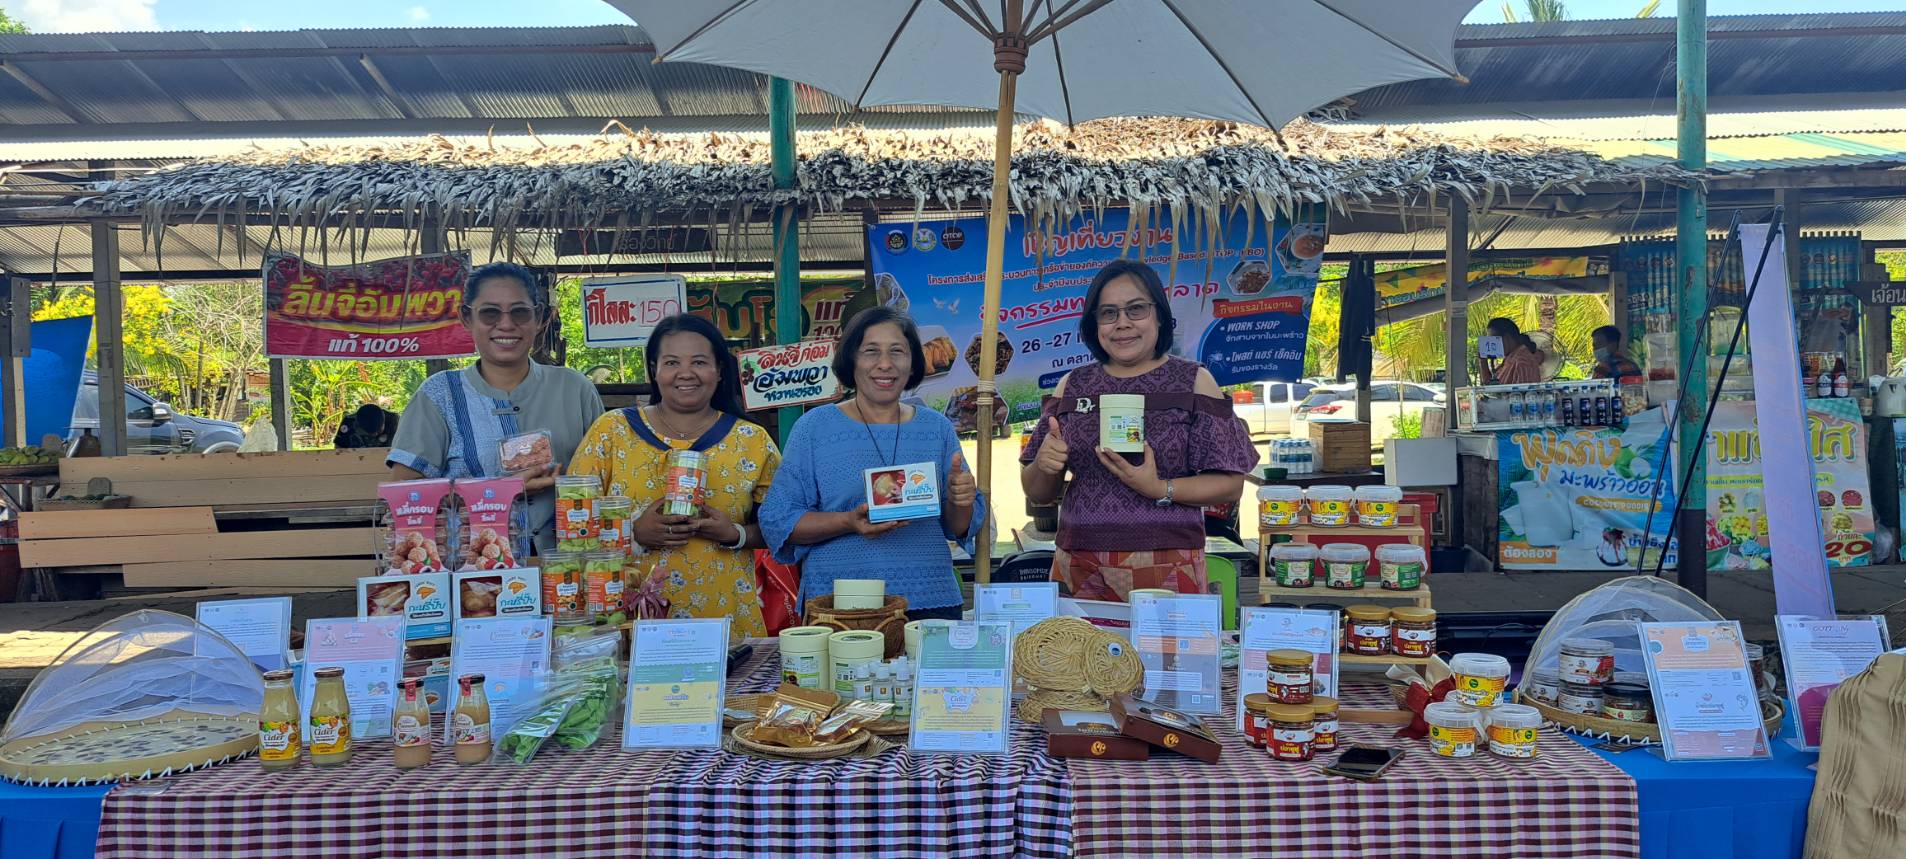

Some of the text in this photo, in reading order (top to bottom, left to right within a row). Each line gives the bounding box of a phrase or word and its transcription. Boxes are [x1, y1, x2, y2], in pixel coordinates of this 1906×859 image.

[640, 299, 680, 324] 150
[1219, 301, 1294, 315] กิจกรรมในงาน
[1227, 320, 1280, 332] WORK SHOP
[328, 334, 420, 353] แท้ 100%
[1021, 339, 1040, 353] 26
[753, 365, 828, 393] อัมพวา
[1824, 540, 1873, 558] 20
